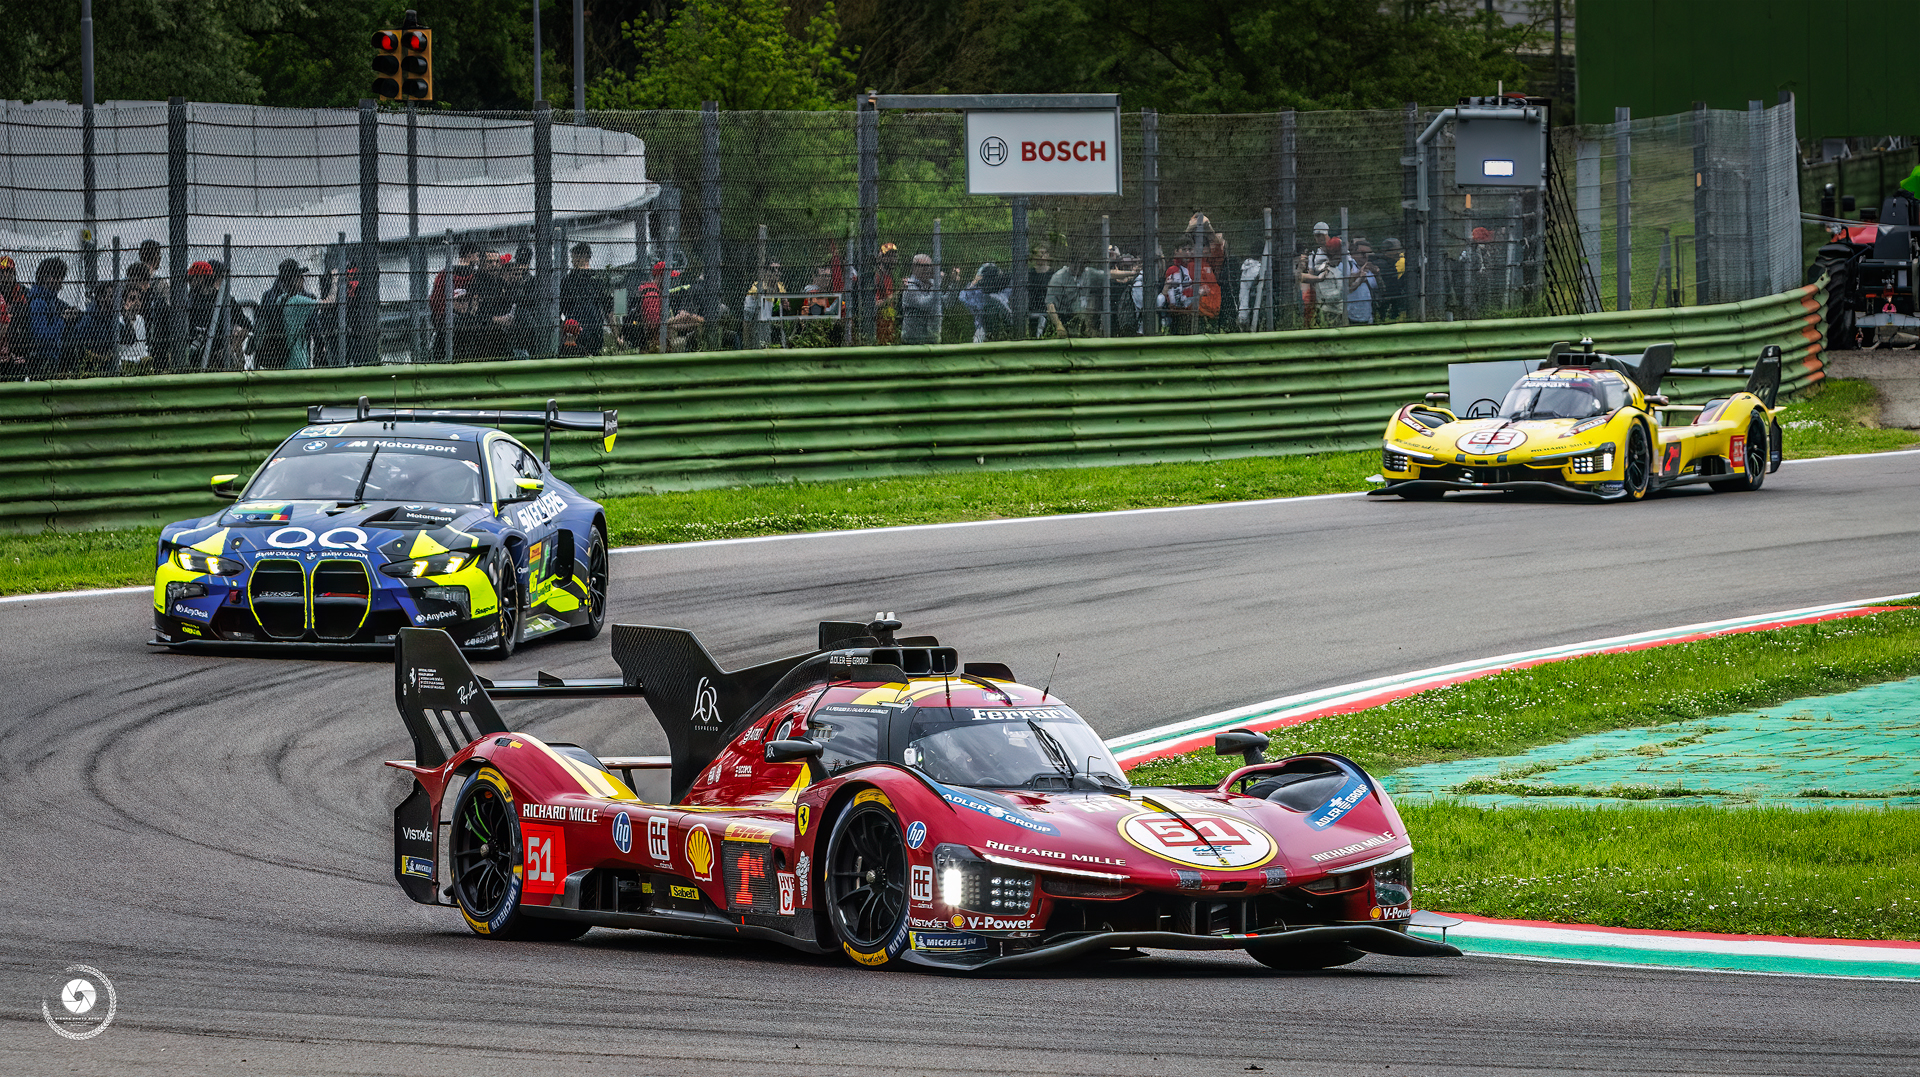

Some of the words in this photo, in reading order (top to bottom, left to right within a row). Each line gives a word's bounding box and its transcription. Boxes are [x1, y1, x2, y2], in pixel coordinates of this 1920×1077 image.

[1021, 140, 1106, 162] BOSCH
[372, 440, 458, 453] Motorsport
[406, 512, 453, 522] Motorsport
[266, 526, 369, 551] OQ
[343, 551, 369, 559] OMAN
[426, 608, 458, 622] AnyDesk
[829, 655, 846, 665] ADLER
[852, 656, 869, 665] GROUP
[971, 708, 1072, 721] Ferrari
[694, 724, 719, 732] ESPRESSO
[522, 803, 567, 820] RICHARD
[568, 807, 599, 823] MILLE
[942, 792, 988, 813] ADLER
[1004, 813, 1053, 833] GROUP
[1313, 806, 1345, 828] ADLER
[1347, 782, 1369, 804] GROUP
[613, 812, 630, 853] hp
[731, 825, 767, 839] DHL
[908, 822, 925, 848] hp
[1144, 819, 1244, 844] 51
[985, 839, 1067, 860] RICHARD
[1071, 853, 1127, 867] MILLE
[1311, 844, 1360, 863] RICHARD
[1360, 830, 1397, 849] MILLE
[527, 836, 555, 882] 51
[672, 886, 698, 900] Sabelt
[491, 886, 518, 930] MICHELIN
[967, 915, 1034, 929] V-Power
[926, 937, 977, 947] MICHELIN
